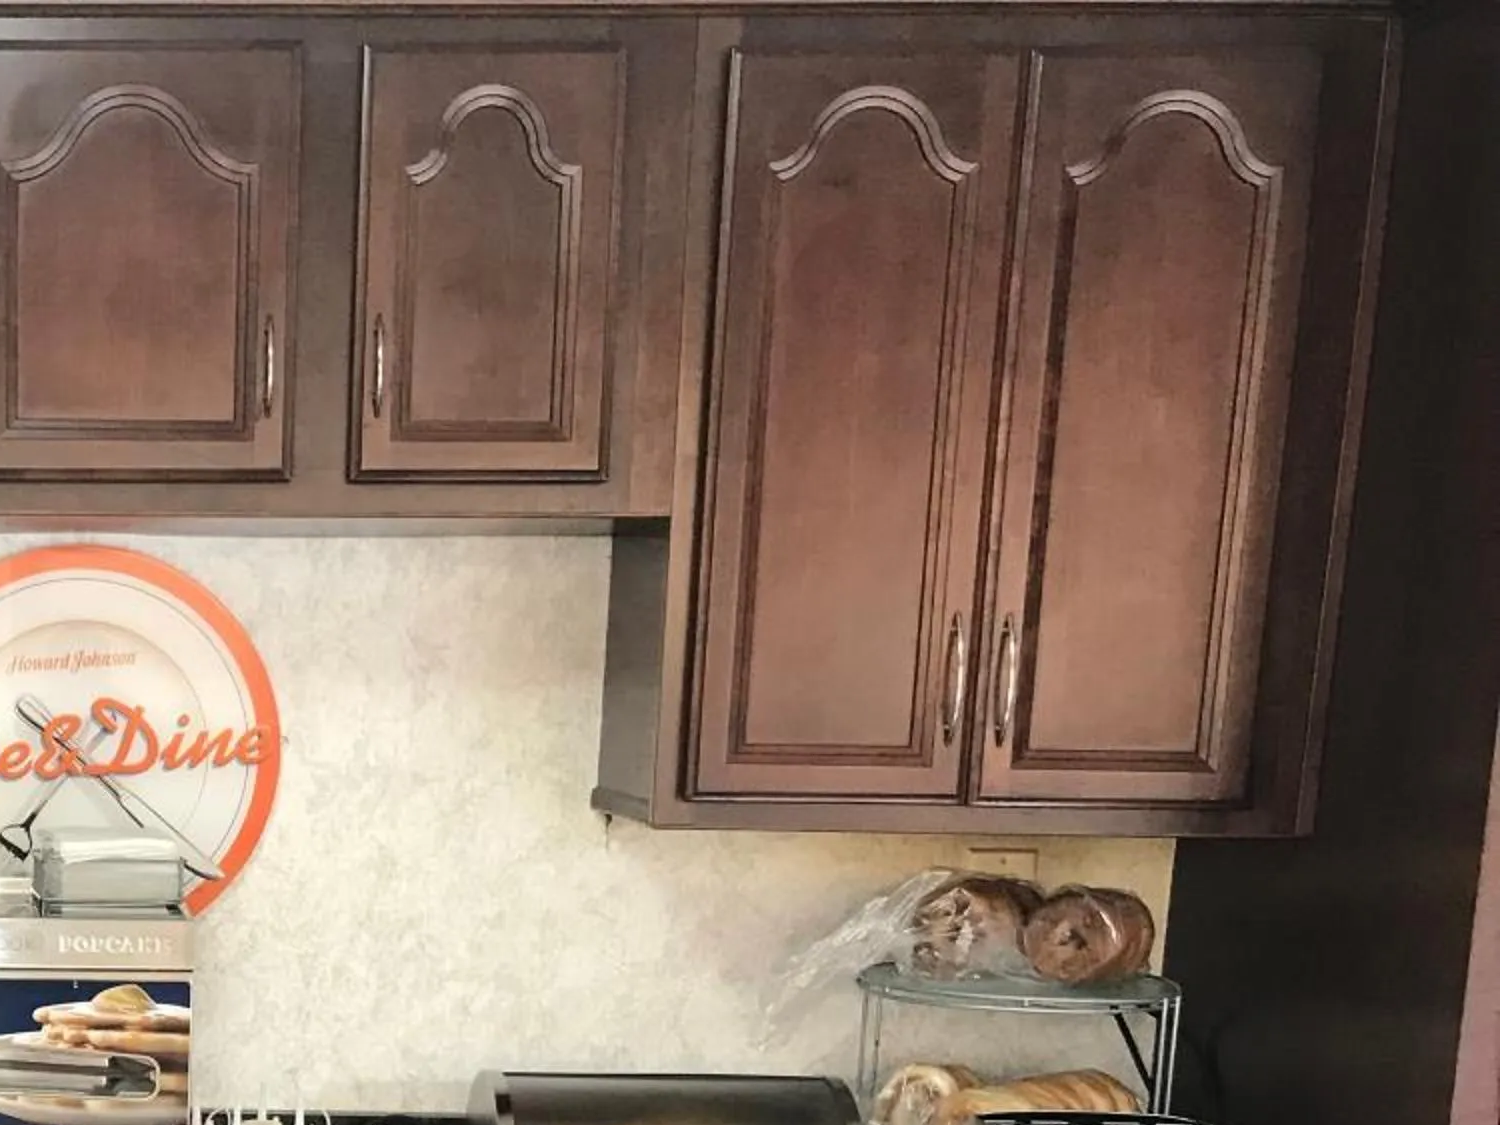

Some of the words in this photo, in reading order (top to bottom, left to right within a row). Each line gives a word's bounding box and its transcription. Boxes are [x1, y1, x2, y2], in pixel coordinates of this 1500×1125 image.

[5, 653, 71, 676] Howard
[70, 650, 138, 673] Johnson
[84, 697, 275, 775] Dine
